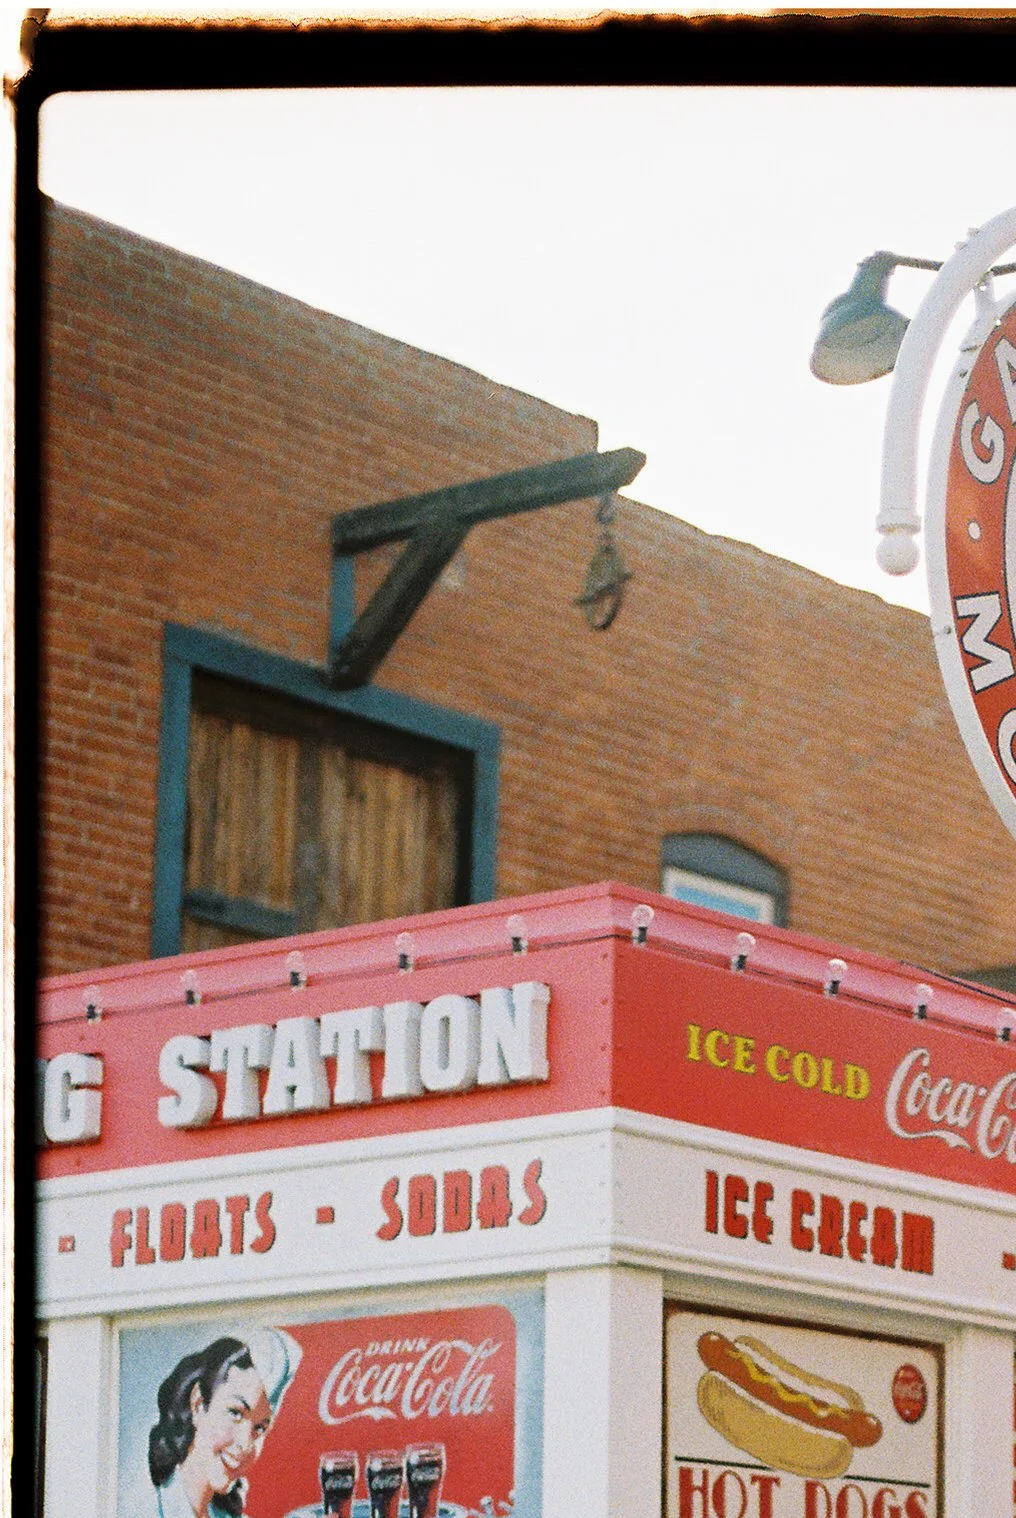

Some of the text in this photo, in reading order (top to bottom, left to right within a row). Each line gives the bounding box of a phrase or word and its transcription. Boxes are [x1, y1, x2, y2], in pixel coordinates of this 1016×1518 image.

[36, 981, 551, 1146] G STATION
[686, 1023, 756, 1076] ICE
[764, 1043, 872, 1102] COLD
[110, 1158, 548, 1267] FLOATS SODAS
[705, 1168, 935, 1276] ICE CREAM
[318, 1337, 502, 1426] Coca-Cola
[364, 1337, 431, 1357] DRINK
